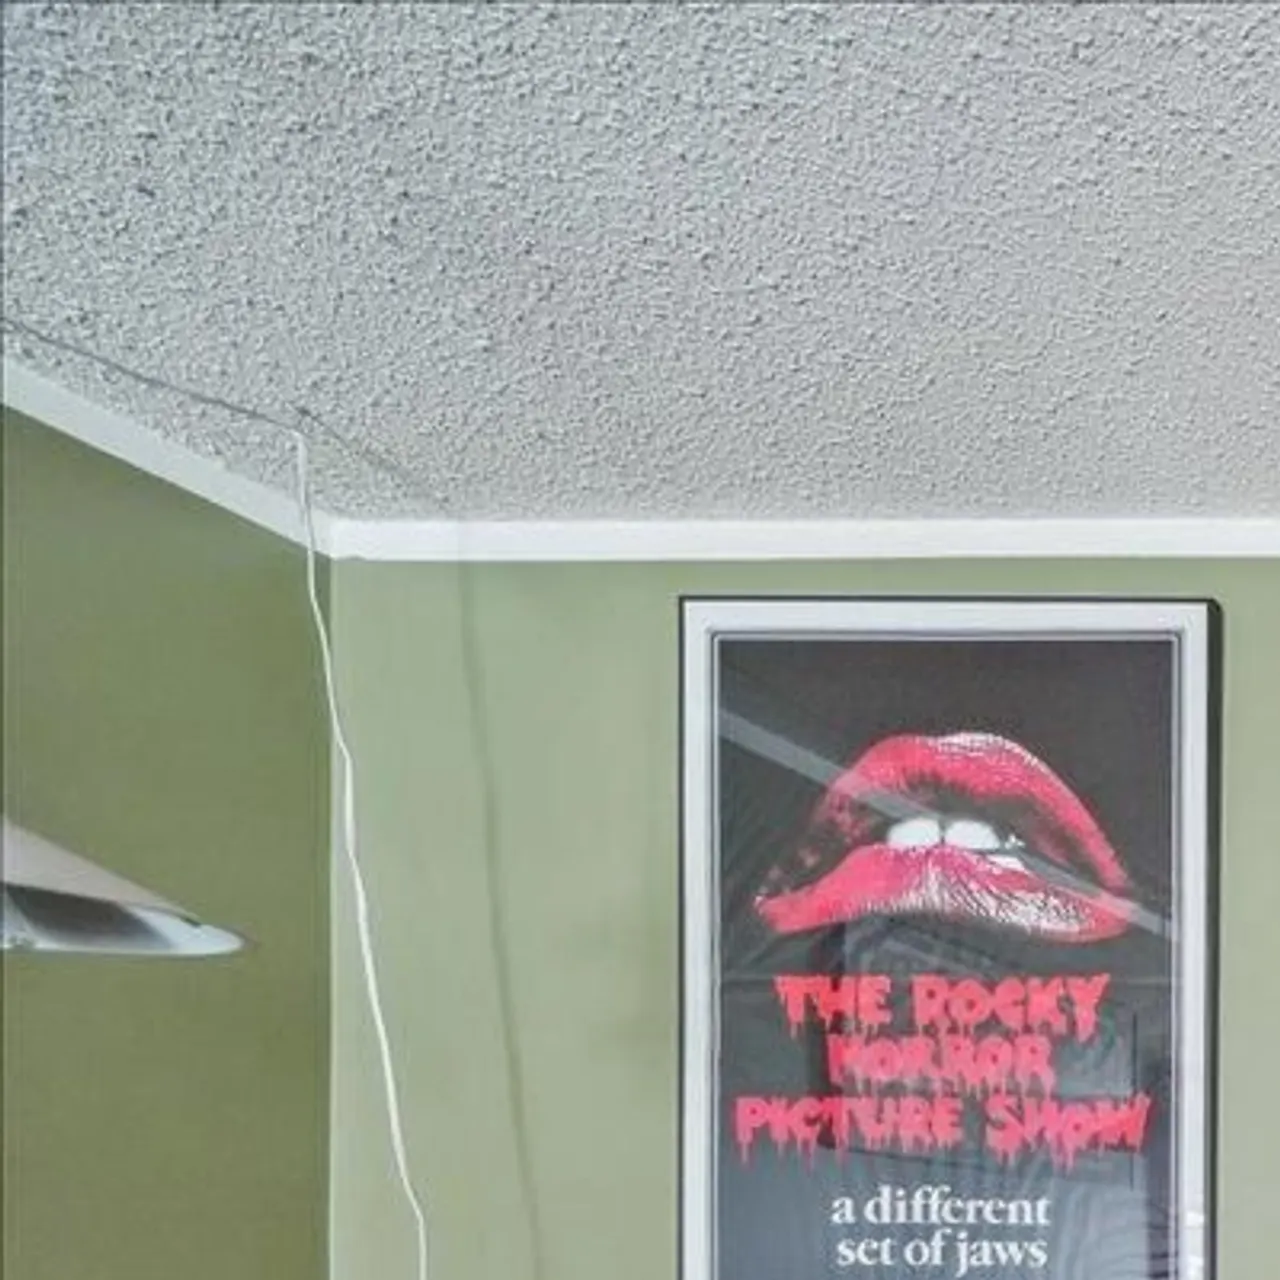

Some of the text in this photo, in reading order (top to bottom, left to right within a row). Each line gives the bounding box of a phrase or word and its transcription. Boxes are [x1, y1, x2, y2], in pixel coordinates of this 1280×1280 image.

[774, 972, 1110, 1042] THE ROCKY
[827, 1033, 1056, 1098] HORROR
[736, 1091, 1151, 1172] PICTURE SHOW
[831, 1183, 1051, 1226] a different
[836, 1228, 1048, 1278] set of jaws
